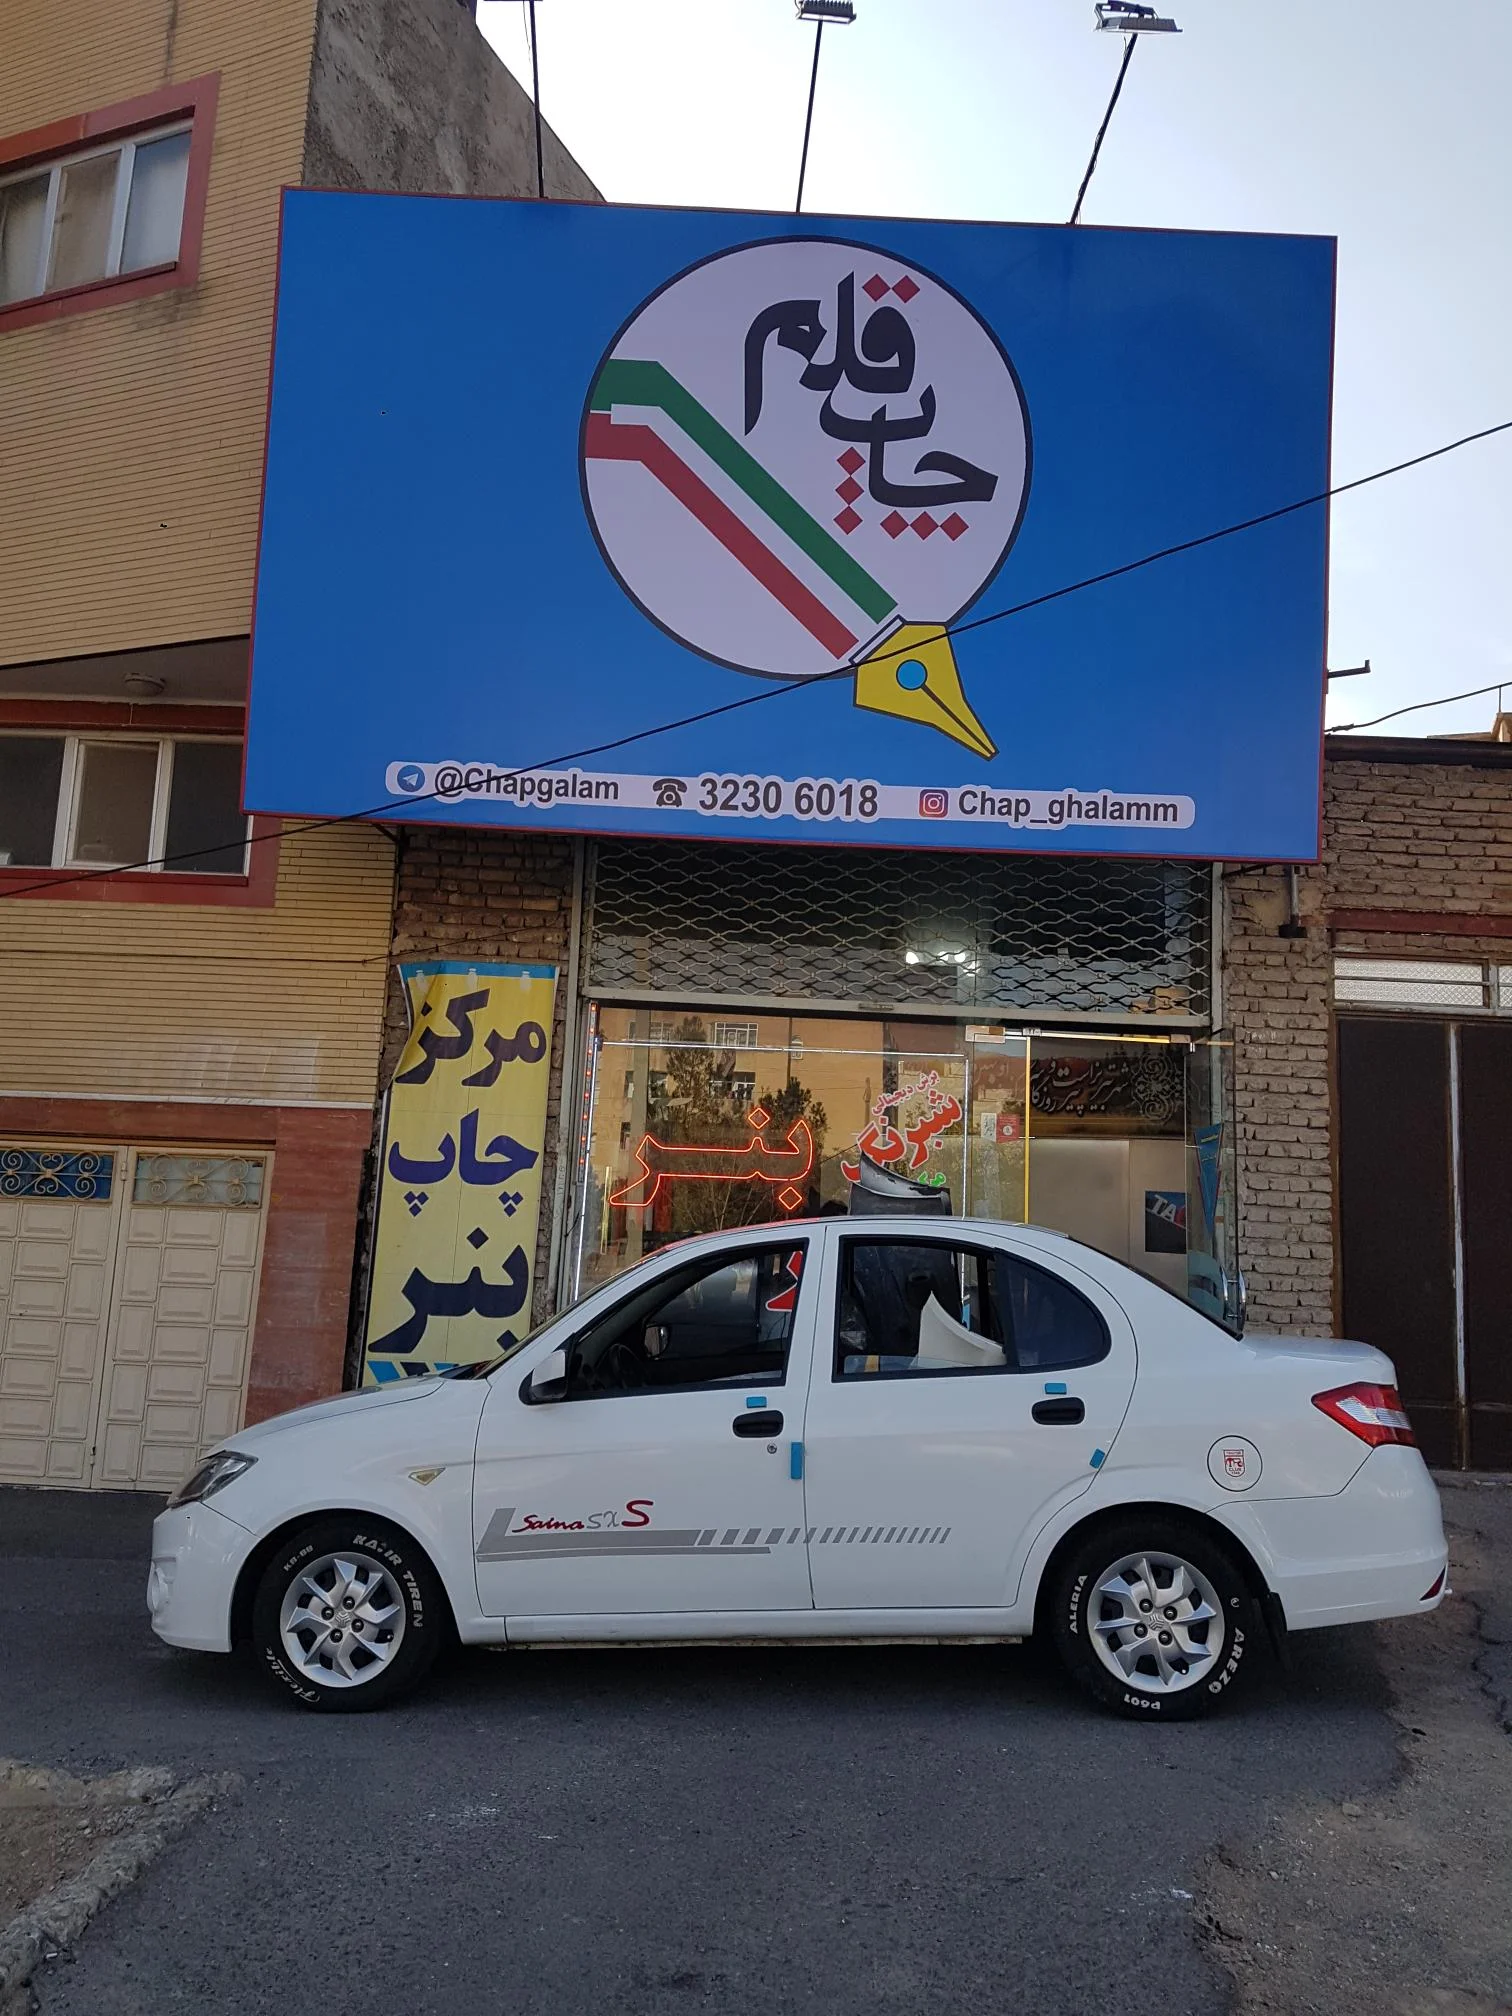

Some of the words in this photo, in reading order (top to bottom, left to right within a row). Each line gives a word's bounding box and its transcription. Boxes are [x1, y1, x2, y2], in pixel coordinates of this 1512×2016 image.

[744, 271, 921, 437] قلم
[819, 383, 999, 541] چاپ
[435, 766, 619, 803] @Chapgalam
[699, 778, 782, 812] 3230
[794, 783, 879, 817] 6018
[958, 790, 1179, 825] Chap_ghalamm
[395, 988, 547, 1087] مرکز
[388, 1108, 539, 1218] چاپ
[609, 1107, 813, 1210] بنر
[367, 1227, 529, 1353] بنر
[512, 1514, 585, 1533] Saina
[621, 1499, 654, 1527] S
[1123, 1693, 1161, 1710] P601
